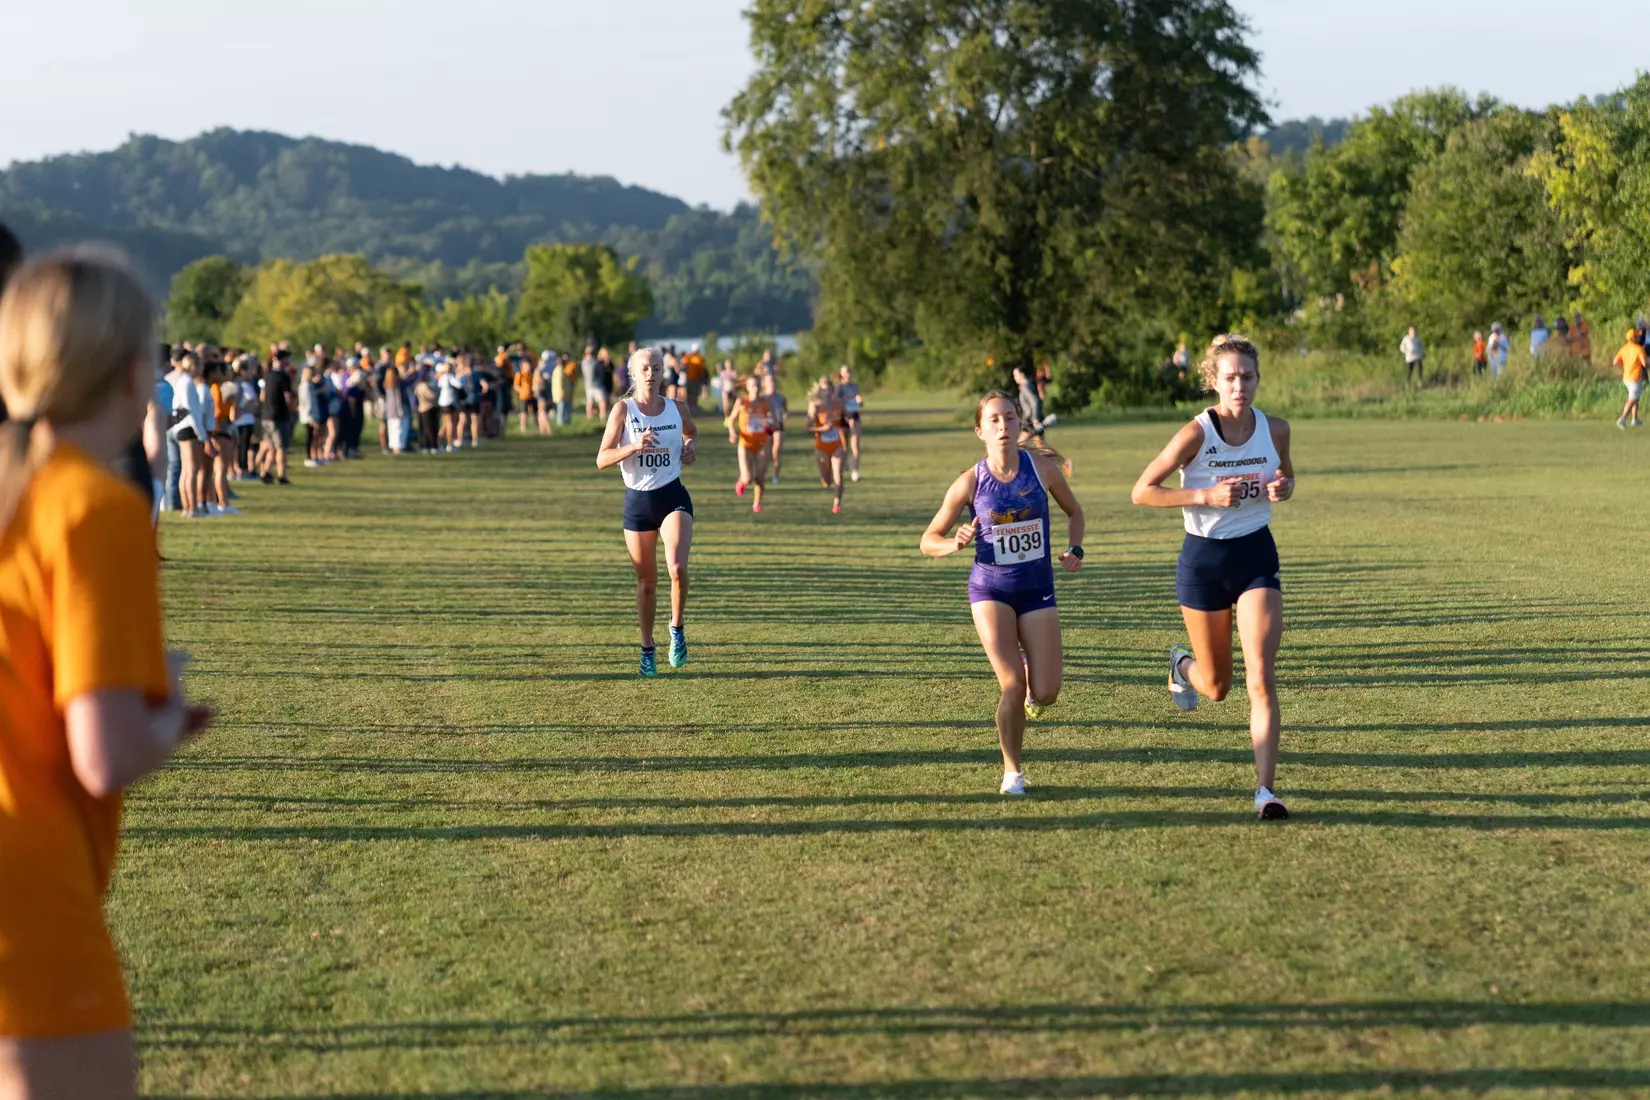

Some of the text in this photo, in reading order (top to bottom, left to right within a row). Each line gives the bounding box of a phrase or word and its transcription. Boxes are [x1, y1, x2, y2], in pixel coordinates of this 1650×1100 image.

[638, 454, 670, 467] 1008
[1208, 457, 1267, 467] CHATTANOOGA
[996, 524, 1039, 535] TENNESSEE
[997, 531, 1041, 554] 1039
